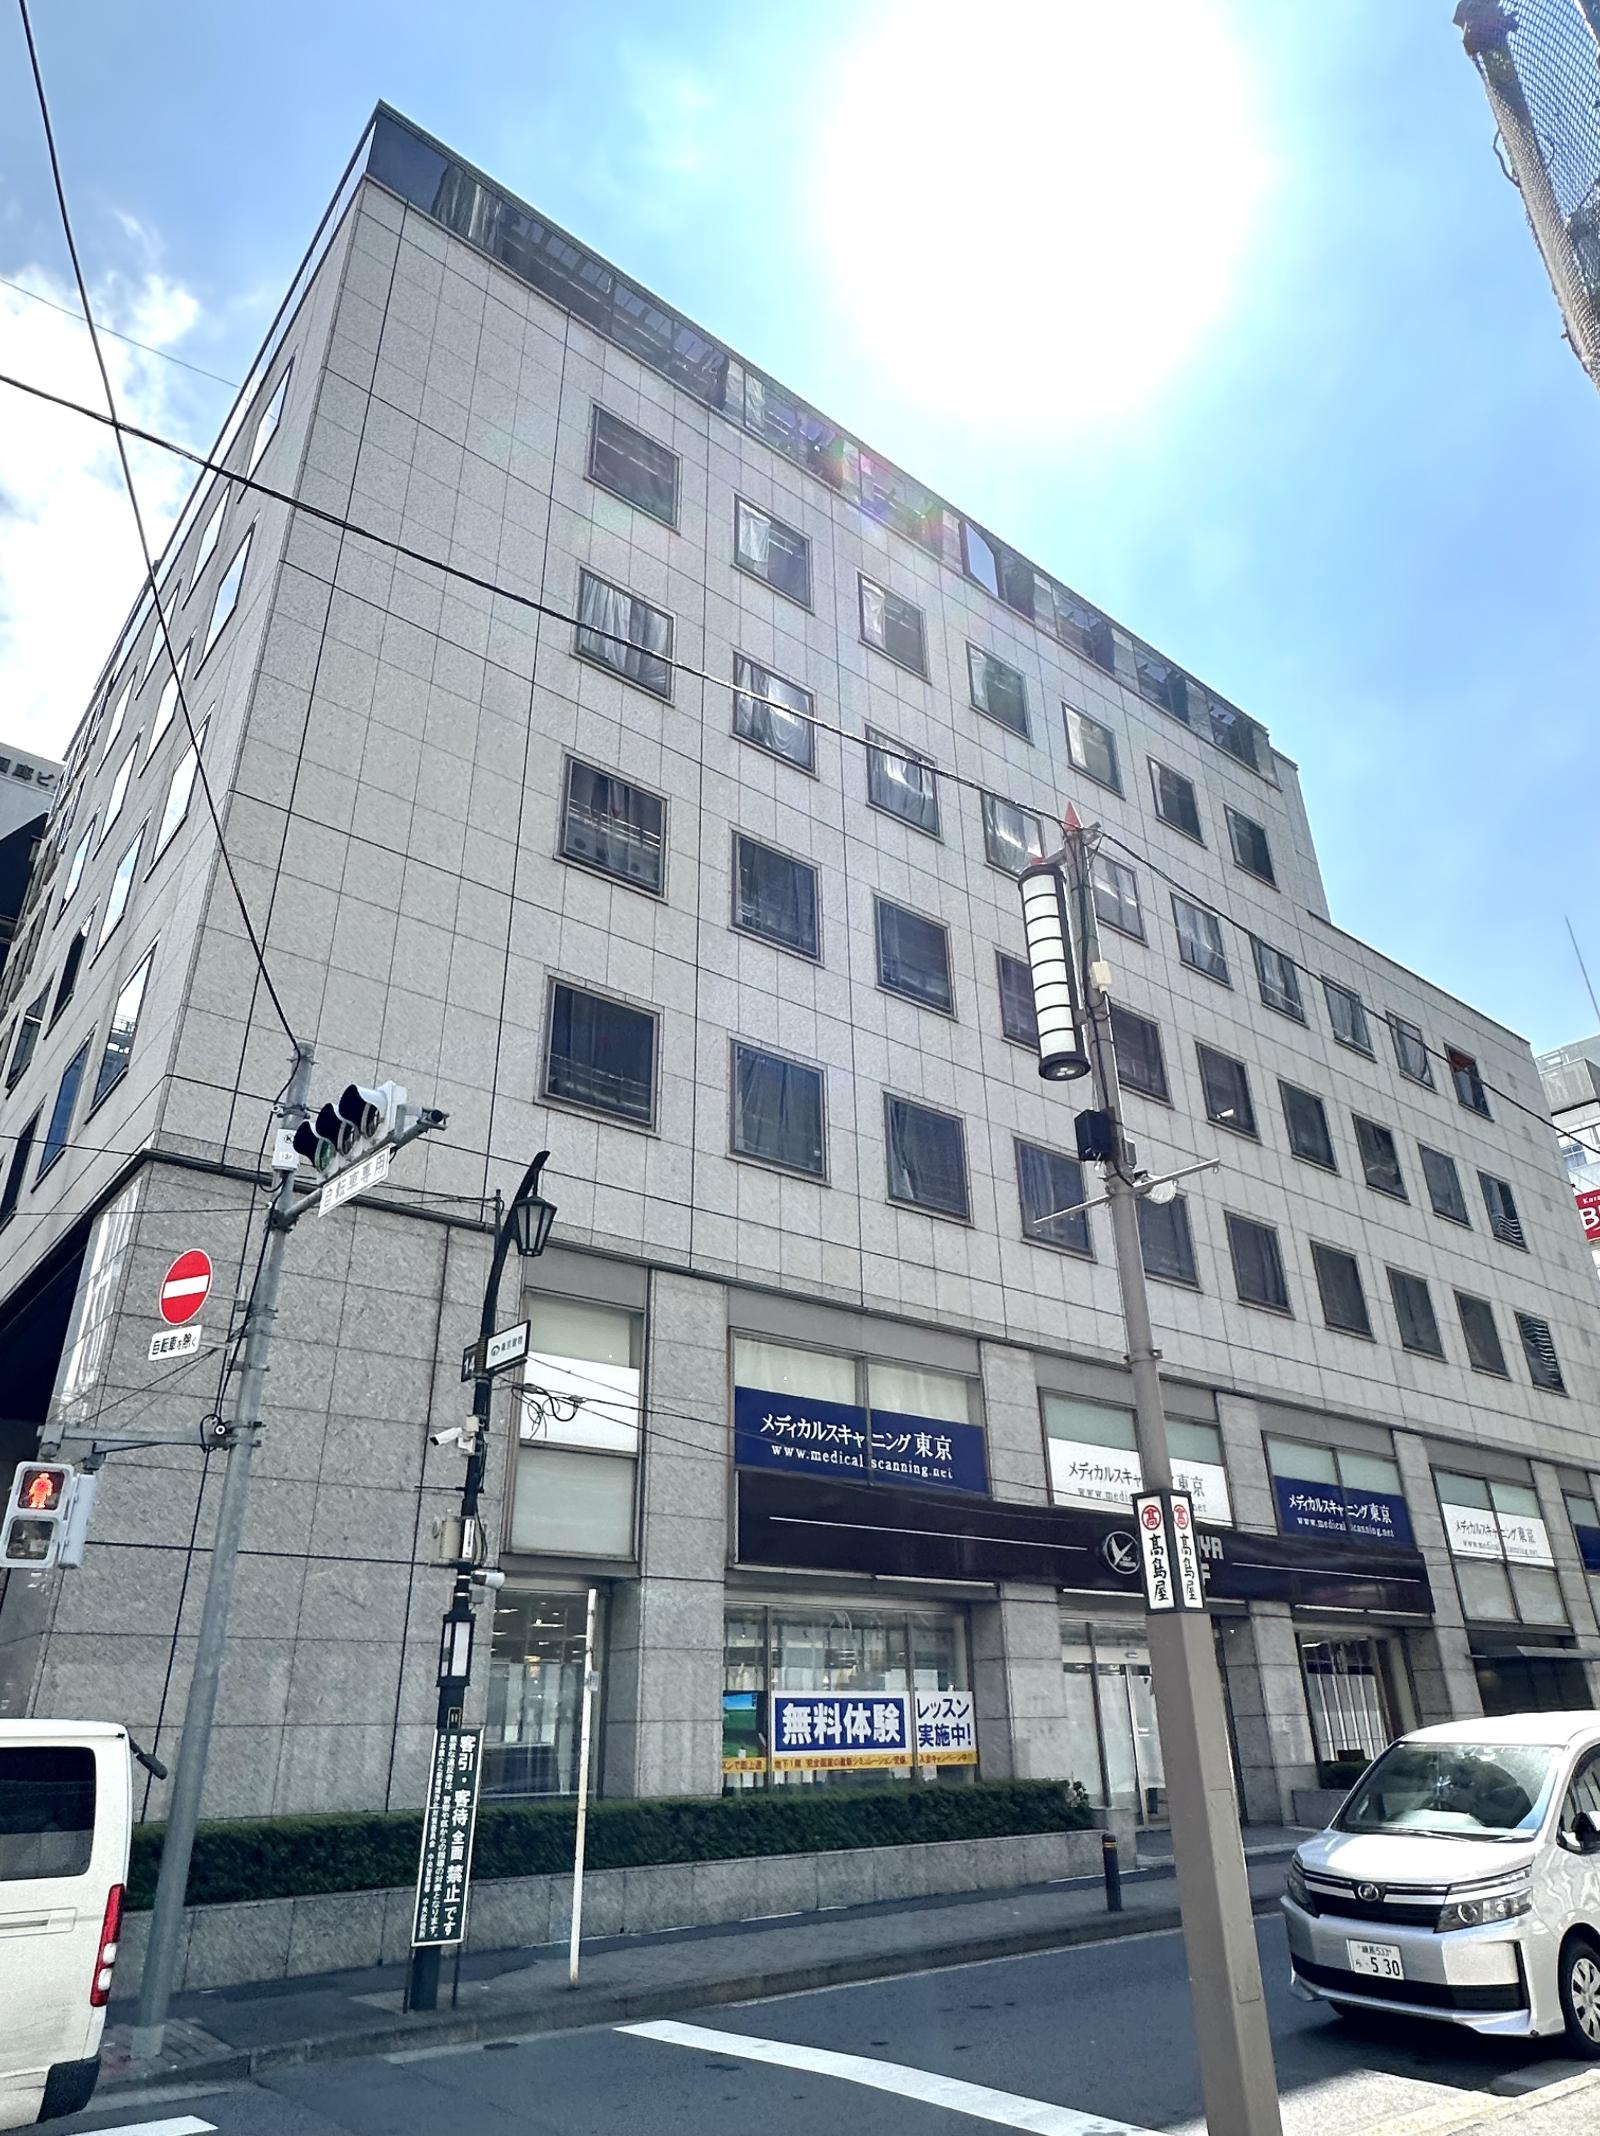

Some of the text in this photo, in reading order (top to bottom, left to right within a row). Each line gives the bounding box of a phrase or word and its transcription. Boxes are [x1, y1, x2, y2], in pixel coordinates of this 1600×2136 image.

[323, 1154, 386, 1208] 自転車専用
[1579, 1204, 1600, 1230] B
[152, 1332, 196, 1355] 自転車を除く
[760, 1413, 953, 1461] メディカルスキャニング東京
[1288, 1494, 1393, 1524] メディカルスキャニング東京
[917, 1698, 970, 1719] レッスン
[783, 1702, 901, 1745] 無料体験
[918, 1723, 971, 1747] 実施中!
